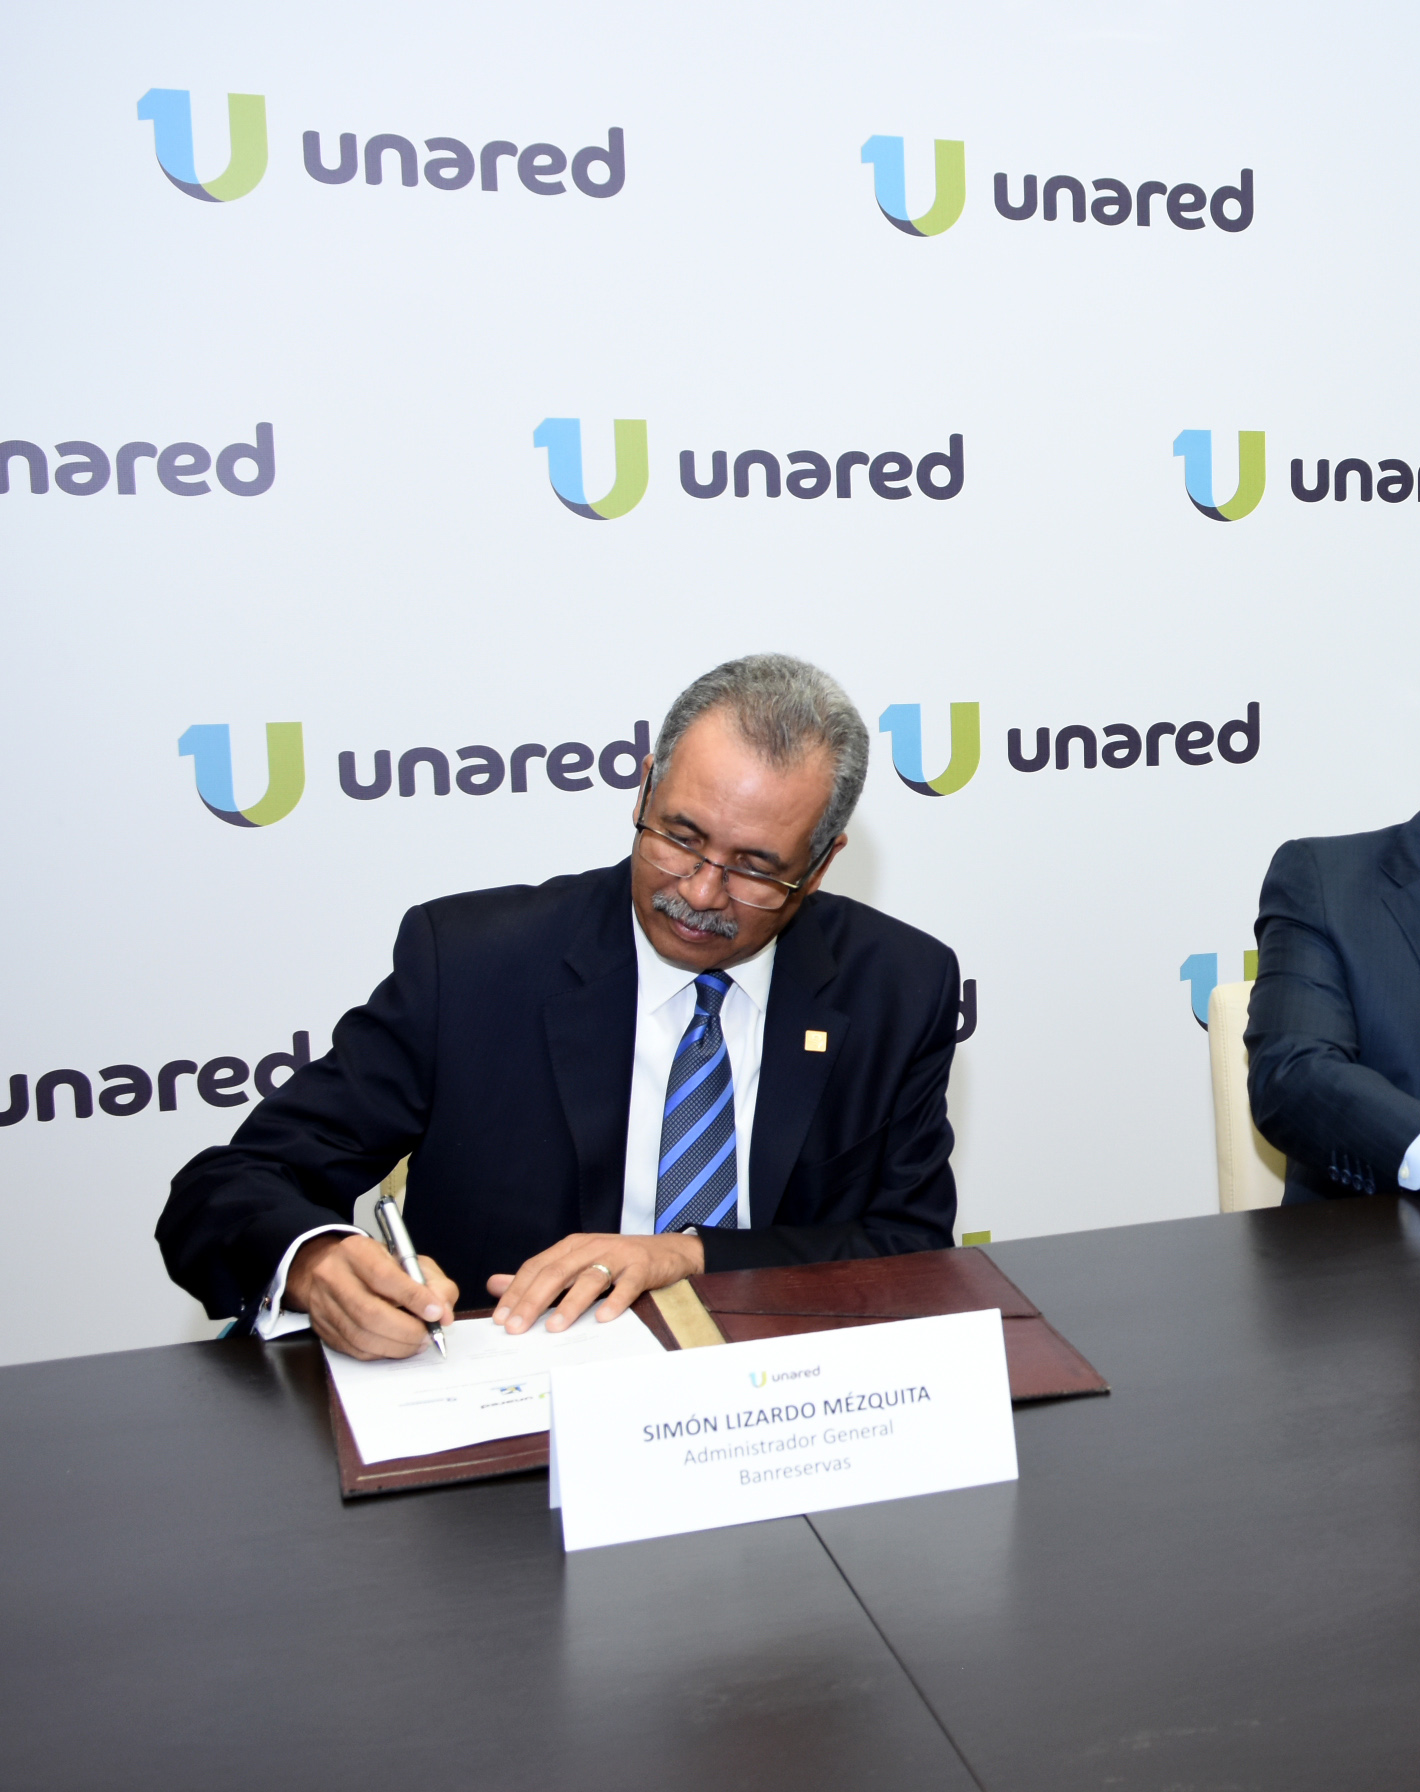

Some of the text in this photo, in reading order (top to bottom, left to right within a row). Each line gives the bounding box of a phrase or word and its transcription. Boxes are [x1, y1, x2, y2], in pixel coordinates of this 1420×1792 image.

[303, 127, 626, 199] unared
[993, 168, 1255, 233] unared
[0, 422, 275, 497] nared
[679, 433, 965, 501] unared
[338, 720, 652, 800] unared
[1007, 701, 1261, 772] unared
[771, 1365, 821, 1382] unared
[642, 1386, 932, 1443] SIMÓN LIZARDO MÉZQUITA
[683, 1419, 895, 1466] Administrador General
[739, 1457, 852, 1485] Banreservas
